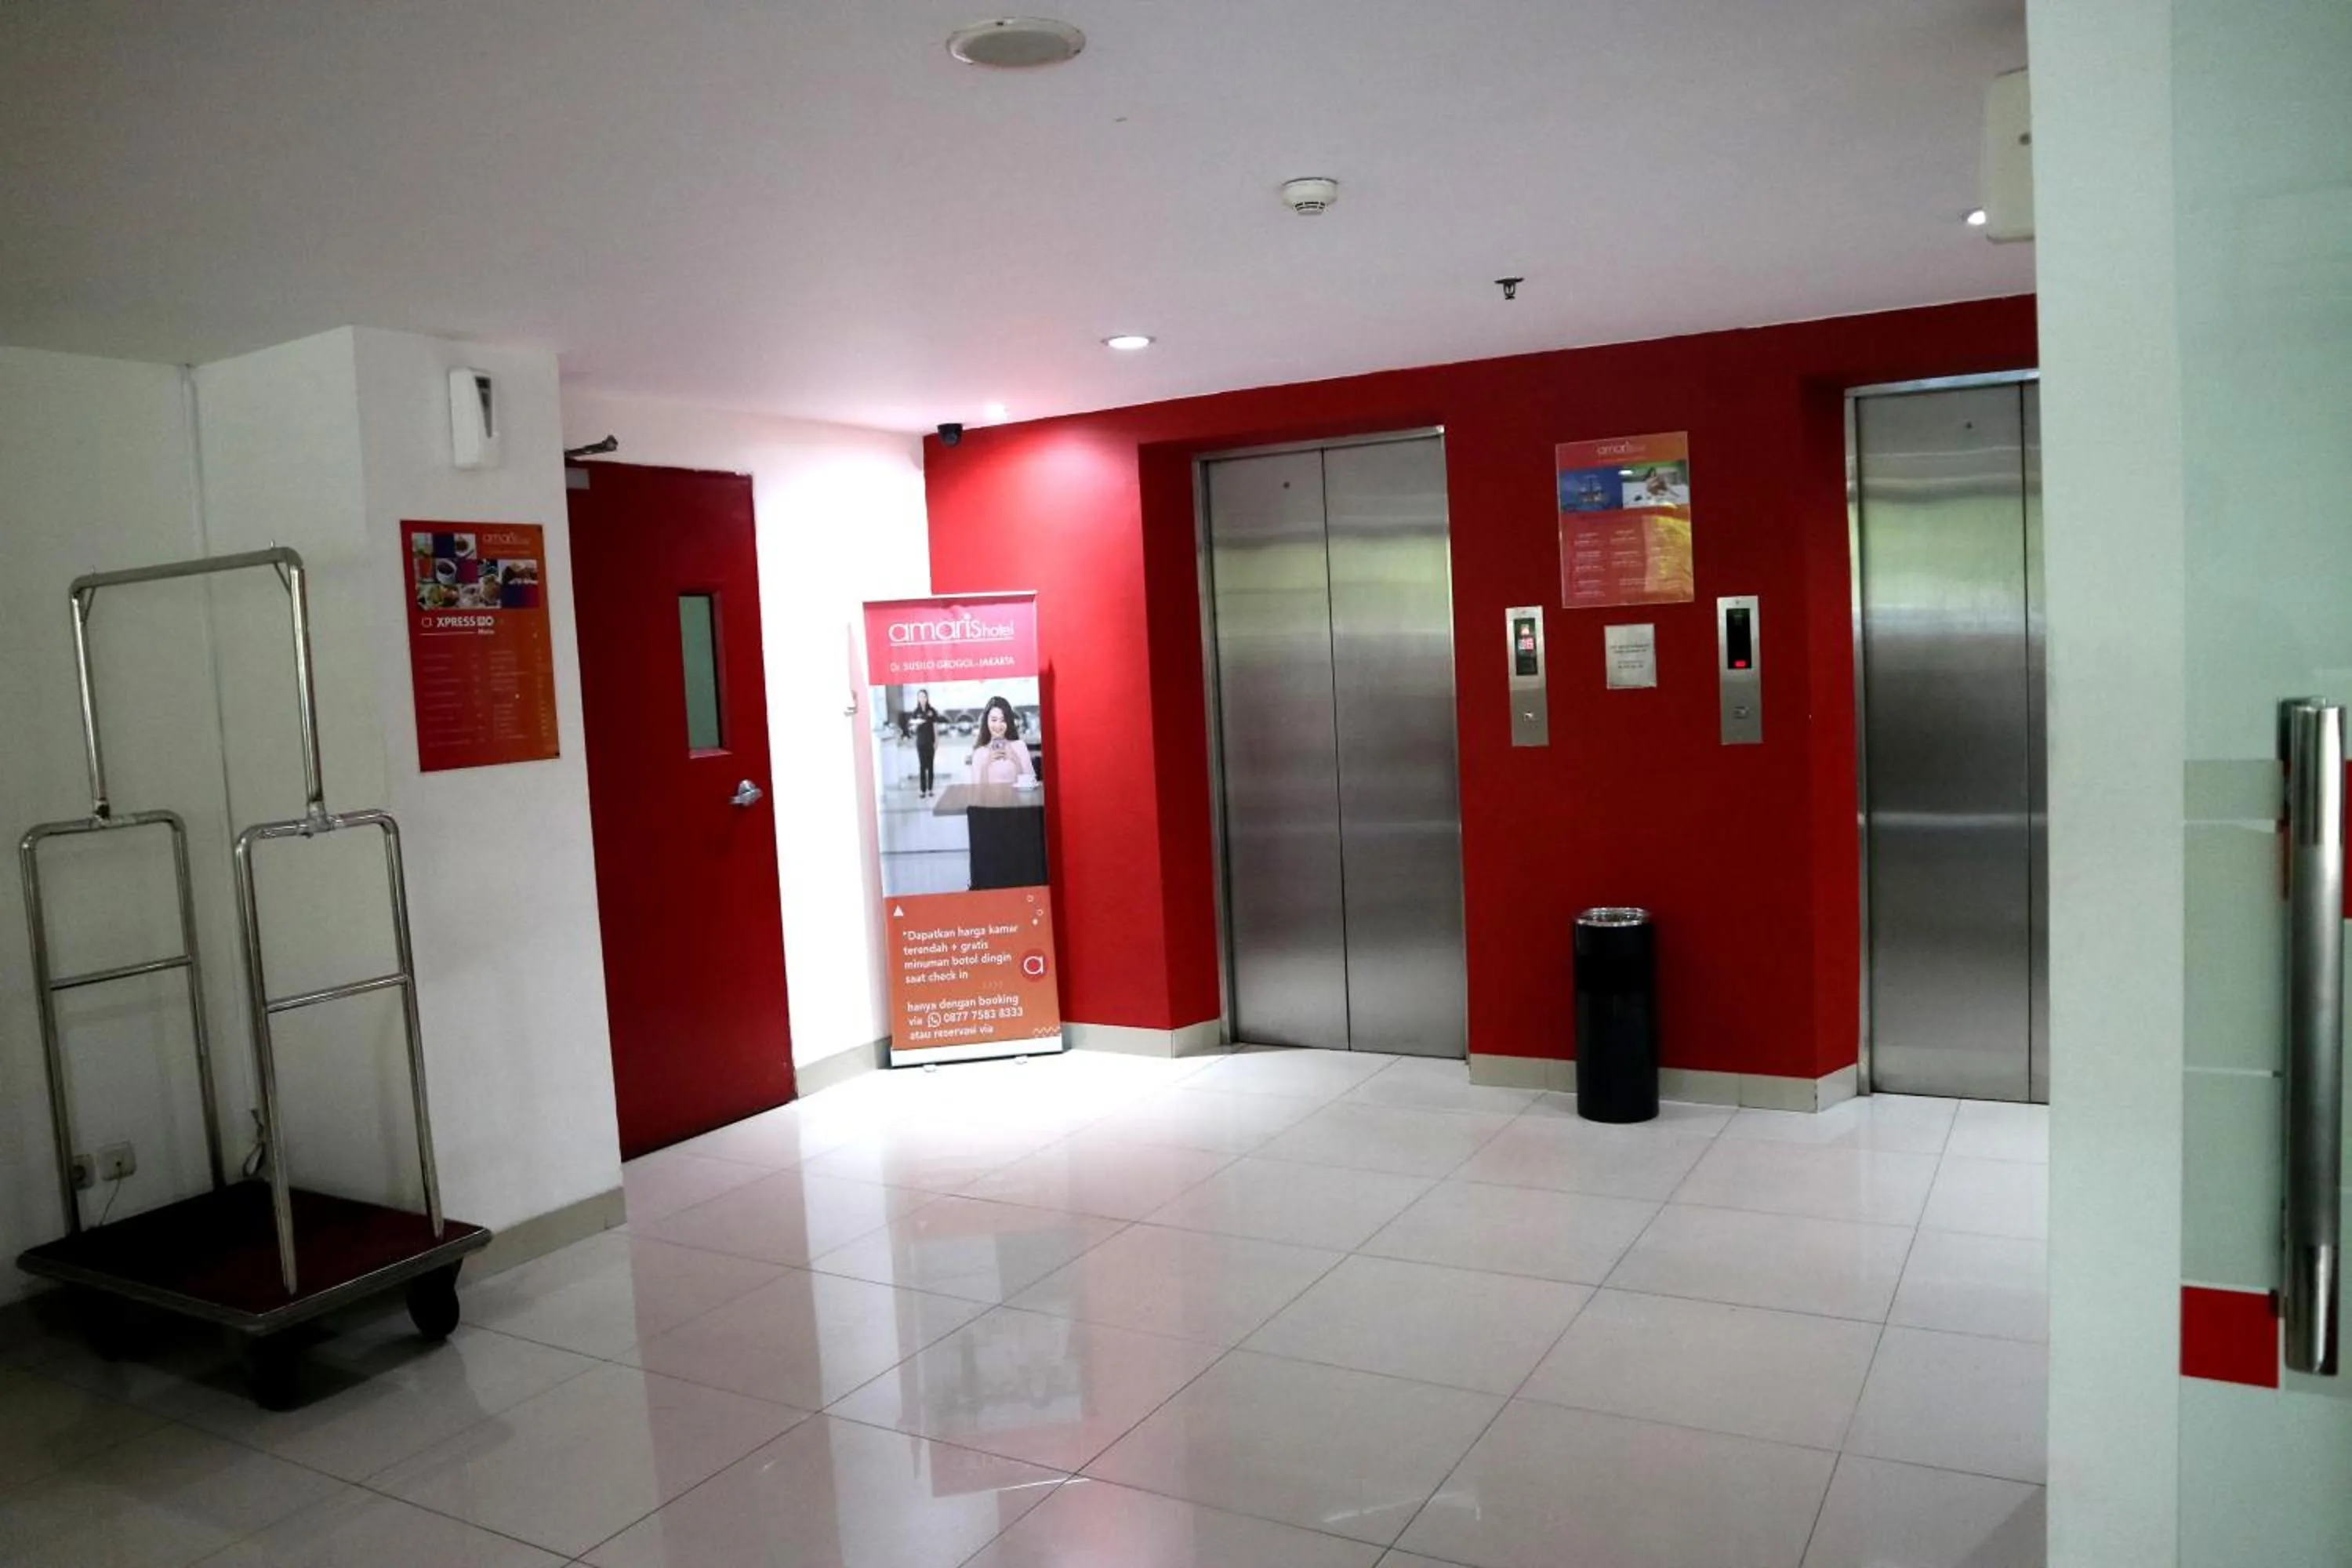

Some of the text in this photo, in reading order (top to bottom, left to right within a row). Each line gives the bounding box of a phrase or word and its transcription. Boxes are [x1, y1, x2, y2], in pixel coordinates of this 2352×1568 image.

[437, 616, 476, 628] XPRESS
[888, 613, 1014, 642] amaris hotel
[902, 660, 935, 671] SUSILO
[936, 659, 974, 669] GROGOL
[979, 656, 1015, 666] JAKARTA
[957, 927, 985, 938] harga
[903, 943, 948, 955] terendah
[960, 940, 989, 953] gratis
[904, 952, 1012, 970] minuman botol dingin
[906, 971, 968, 984] saat check in
[907, 994, 1019, 1013] hanya dengan booking
[909, 1016, 923, 1025] via
[943, 1011, 968, 1023] 0877
[909, 1024, 994, 1040] atau reservasi via
